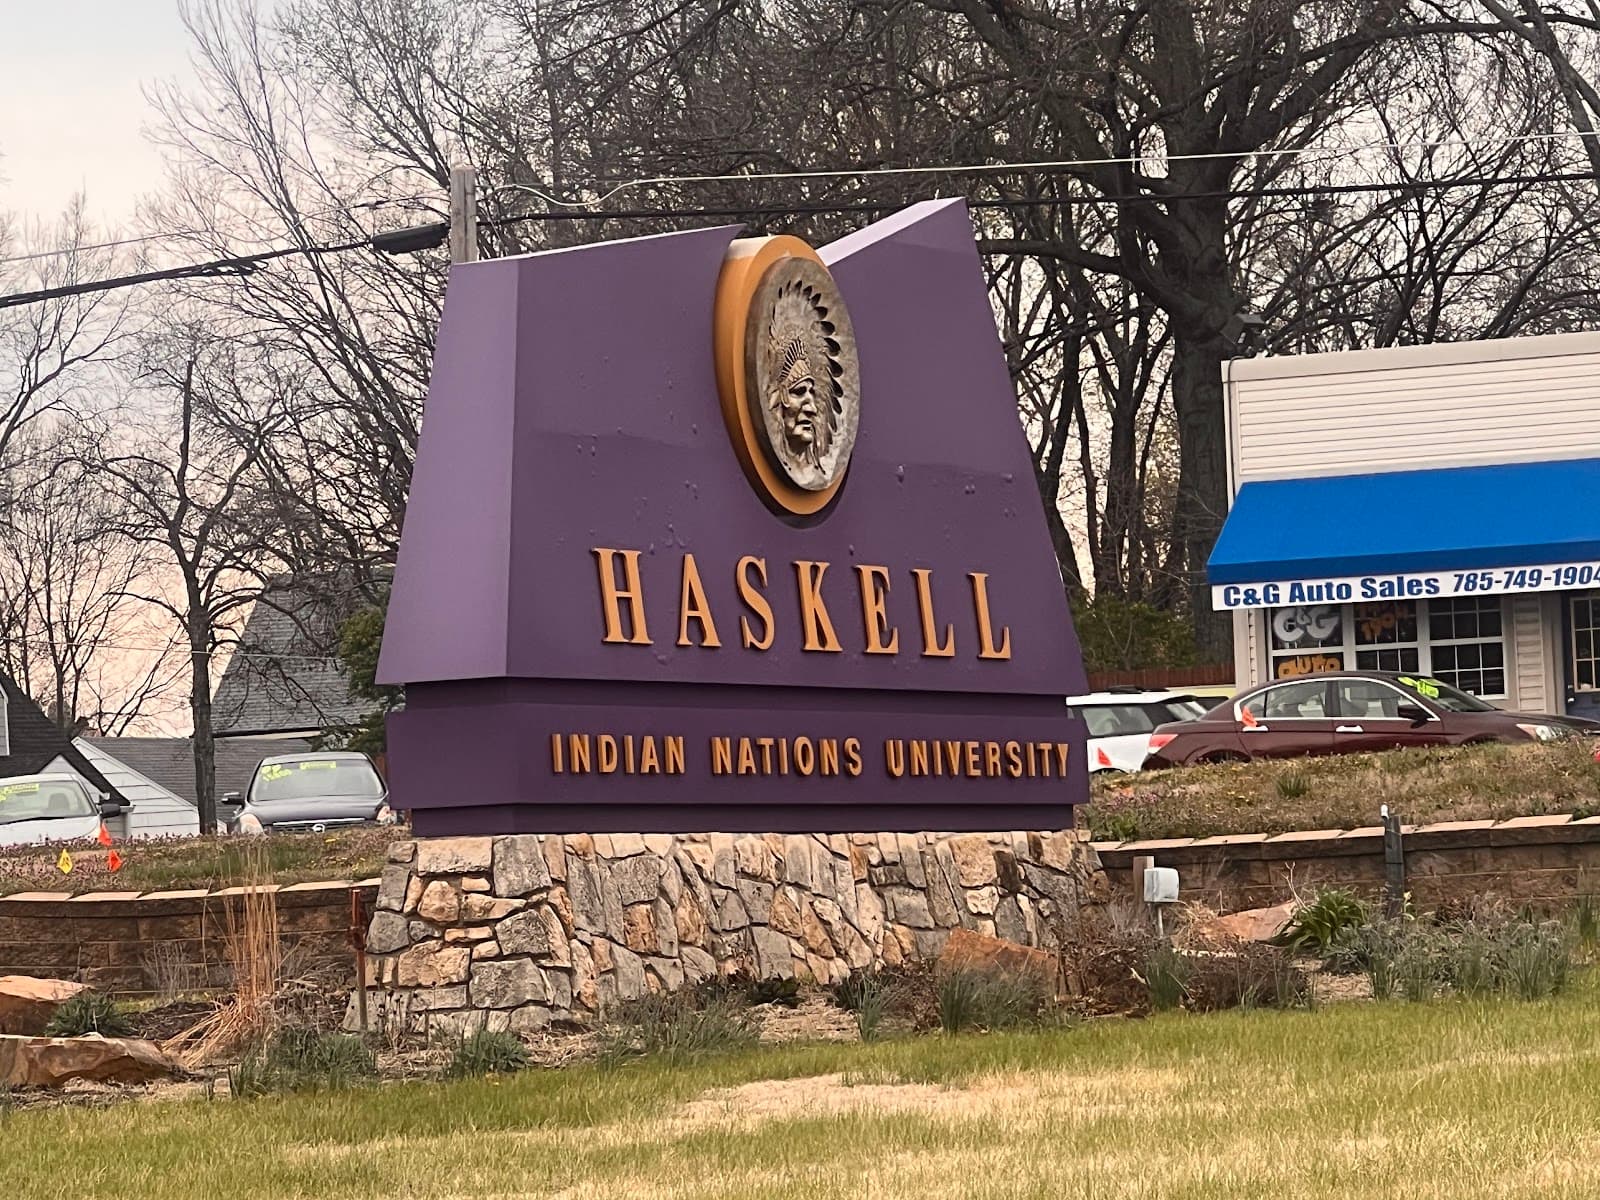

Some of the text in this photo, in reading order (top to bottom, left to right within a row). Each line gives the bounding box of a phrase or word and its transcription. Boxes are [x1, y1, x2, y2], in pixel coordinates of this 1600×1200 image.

[592, 547, 1012, 661] HASKELL
[1223, 583, 1280, 607] C&G
[1289, 581, 1351, 602] Auto
[1360, 576, 1440, 599] Sales
[551, 733, 1070, 777] INDIAN NATIONS UNIVERSITY
